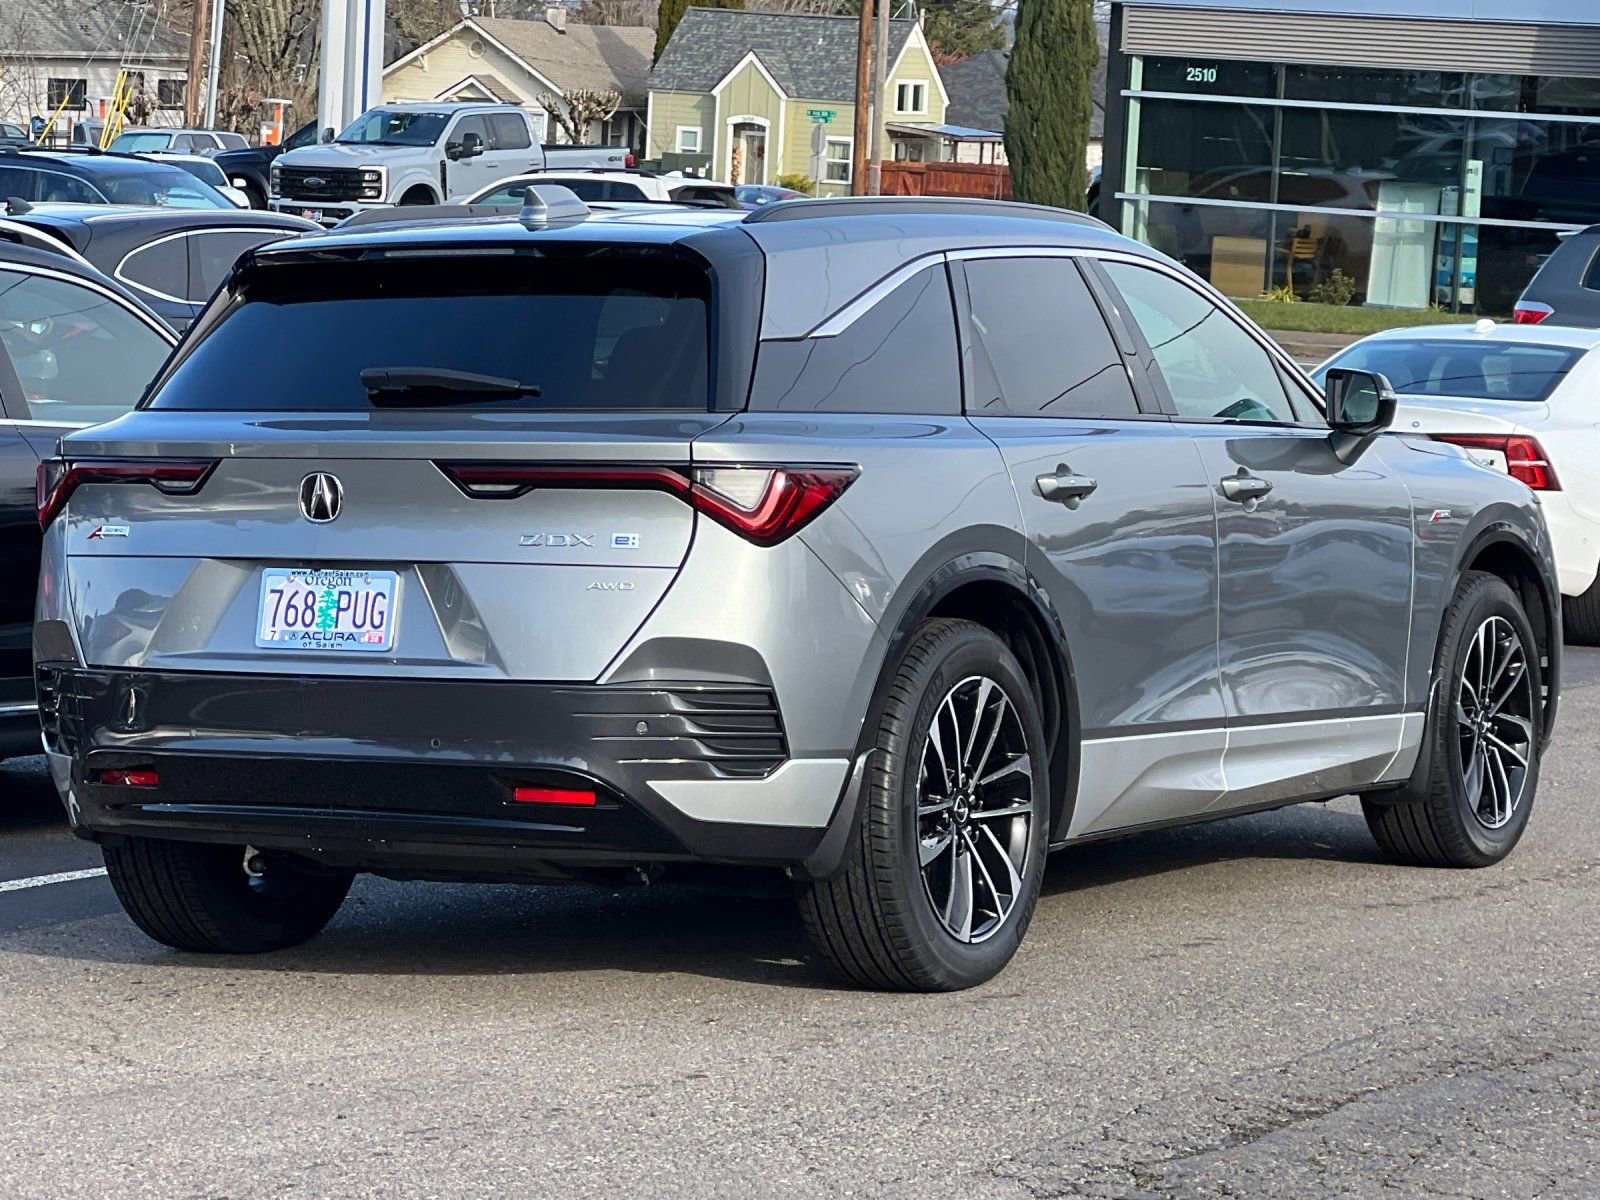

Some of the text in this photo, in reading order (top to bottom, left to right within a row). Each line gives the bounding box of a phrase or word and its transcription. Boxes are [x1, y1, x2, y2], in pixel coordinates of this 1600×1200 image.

[1186, 67, 1217, 82] 2510
[518, 531, 597, 547] ZDX
[304, 575, 352, 589] Oregon
[586, 581, 635, 591] AWD
[269, 588, 387, 630] 768 PUG
[300, 631, 357, 642] ACURA
